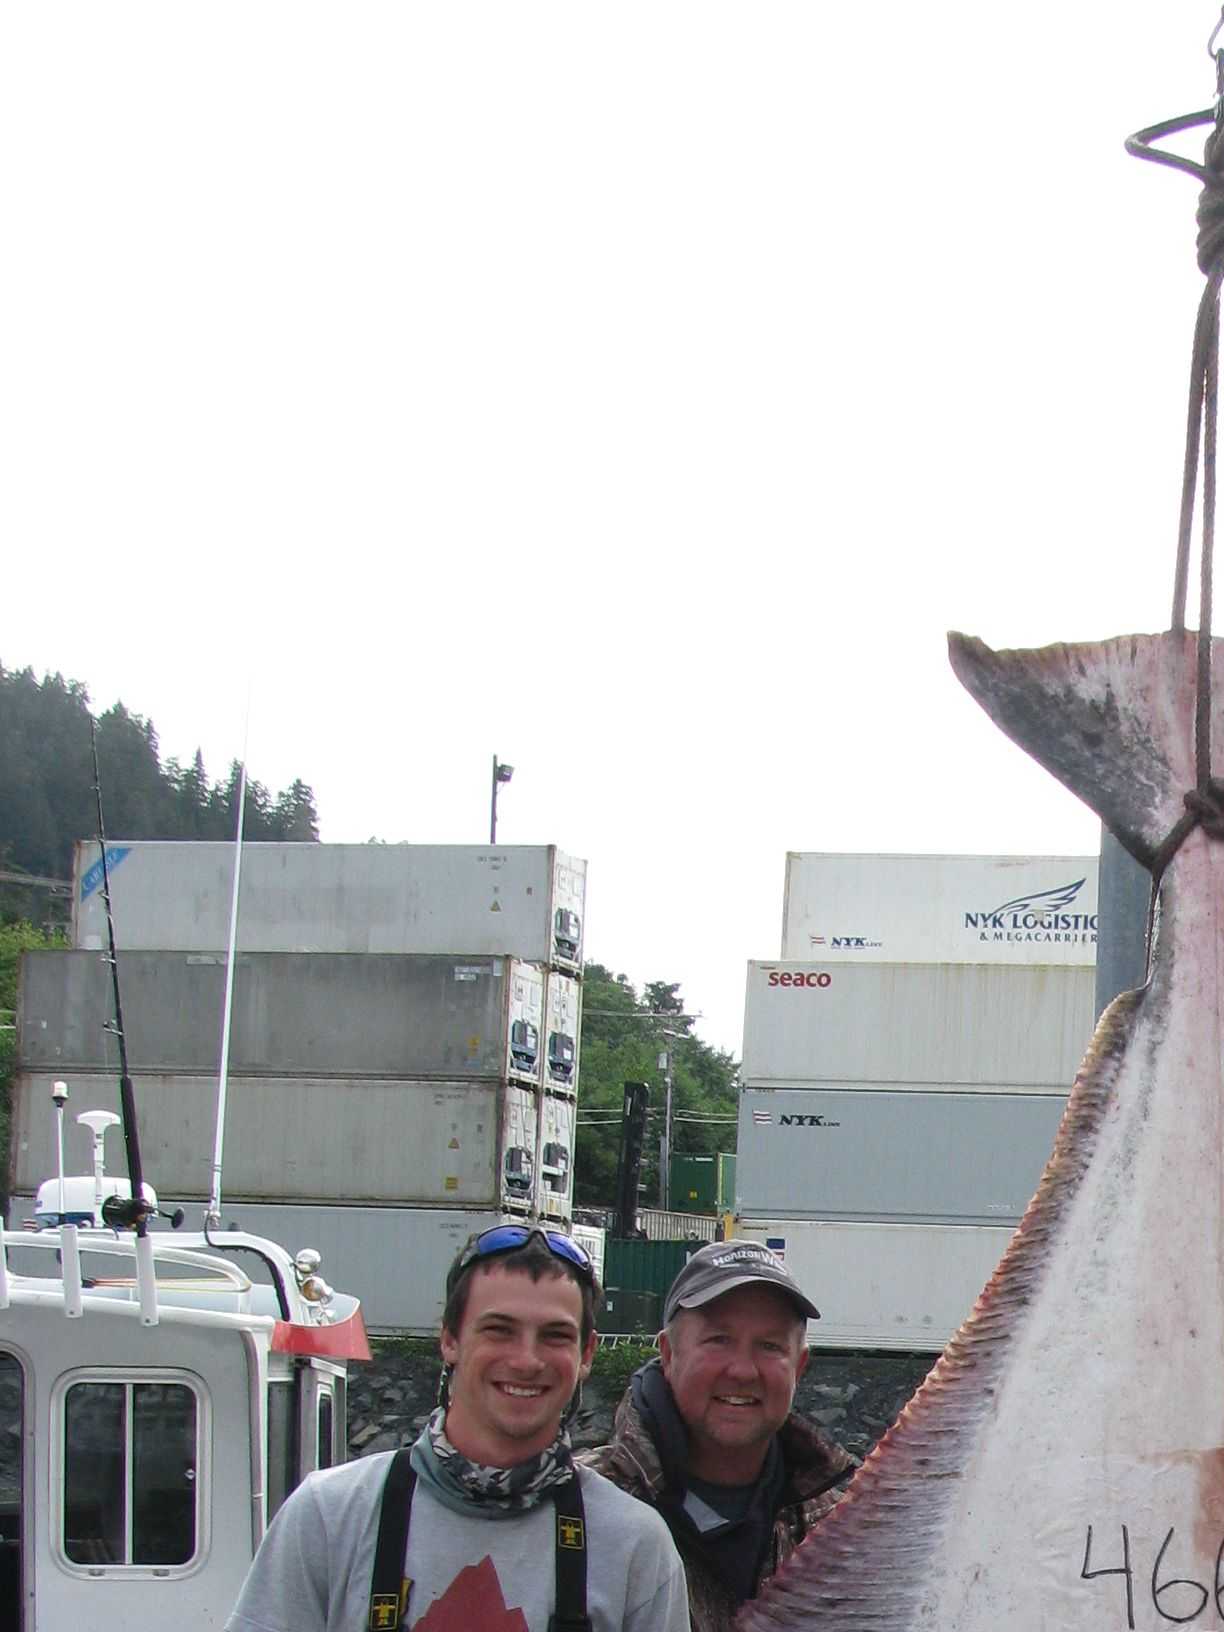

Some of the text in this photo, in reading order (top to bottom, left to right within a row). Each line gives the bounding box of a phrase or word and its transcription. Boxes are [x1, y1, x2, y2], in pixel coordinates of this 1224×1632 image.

[964, 912, 1099, 930] NYK LOGISTIC
[830, 936, 867, 947] NYK
[979, 931, 989, 941] &
[767, 971, 832, 988] seaco
[779, 1114, 825, 1127] NYK
